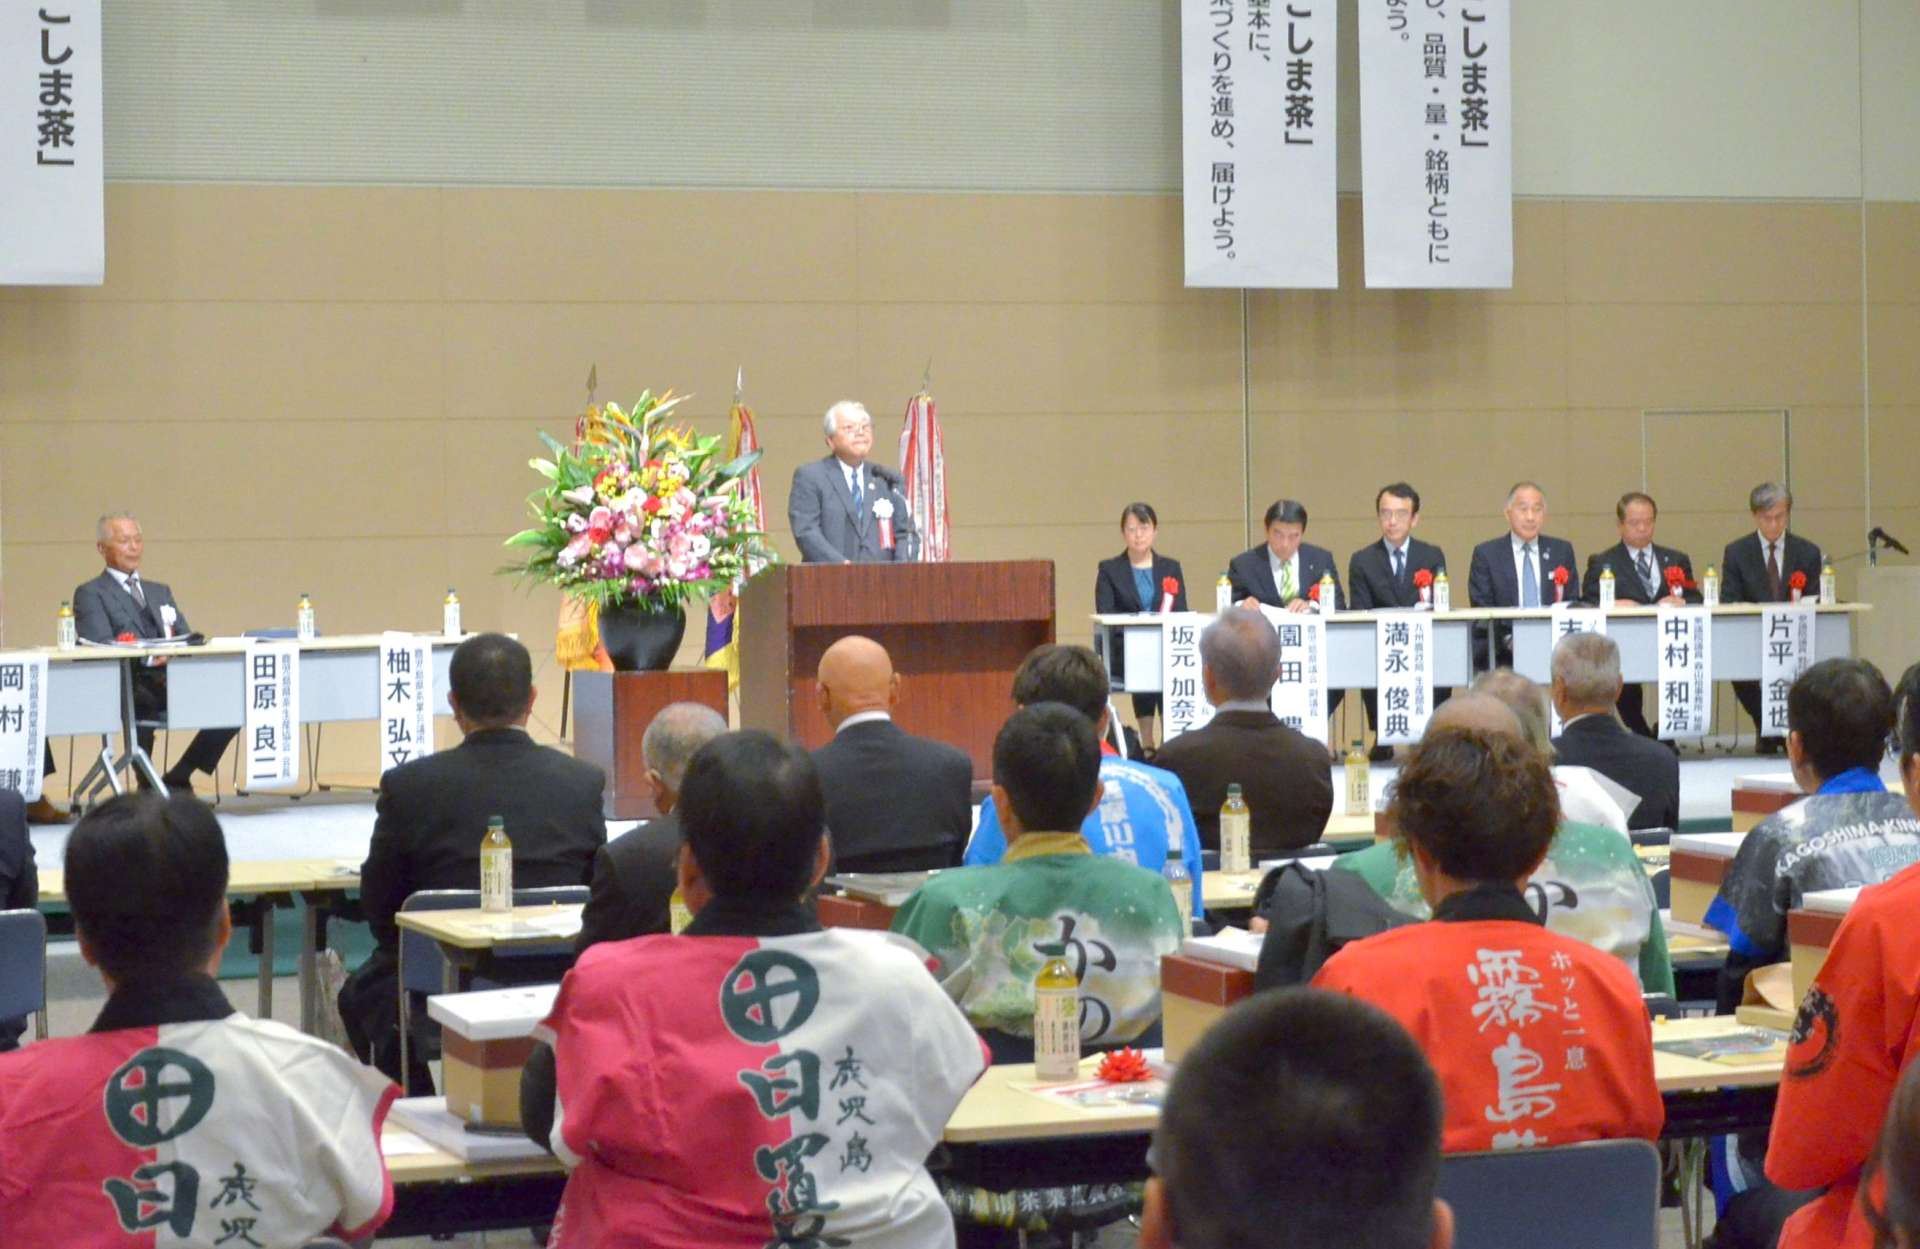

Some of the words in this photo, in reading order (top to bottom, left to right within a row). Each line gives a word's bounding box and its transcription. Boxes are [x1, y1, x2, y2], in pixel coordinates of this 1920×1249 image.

[1209, 0, 1235, 260] づくりを進め、届けよう。
